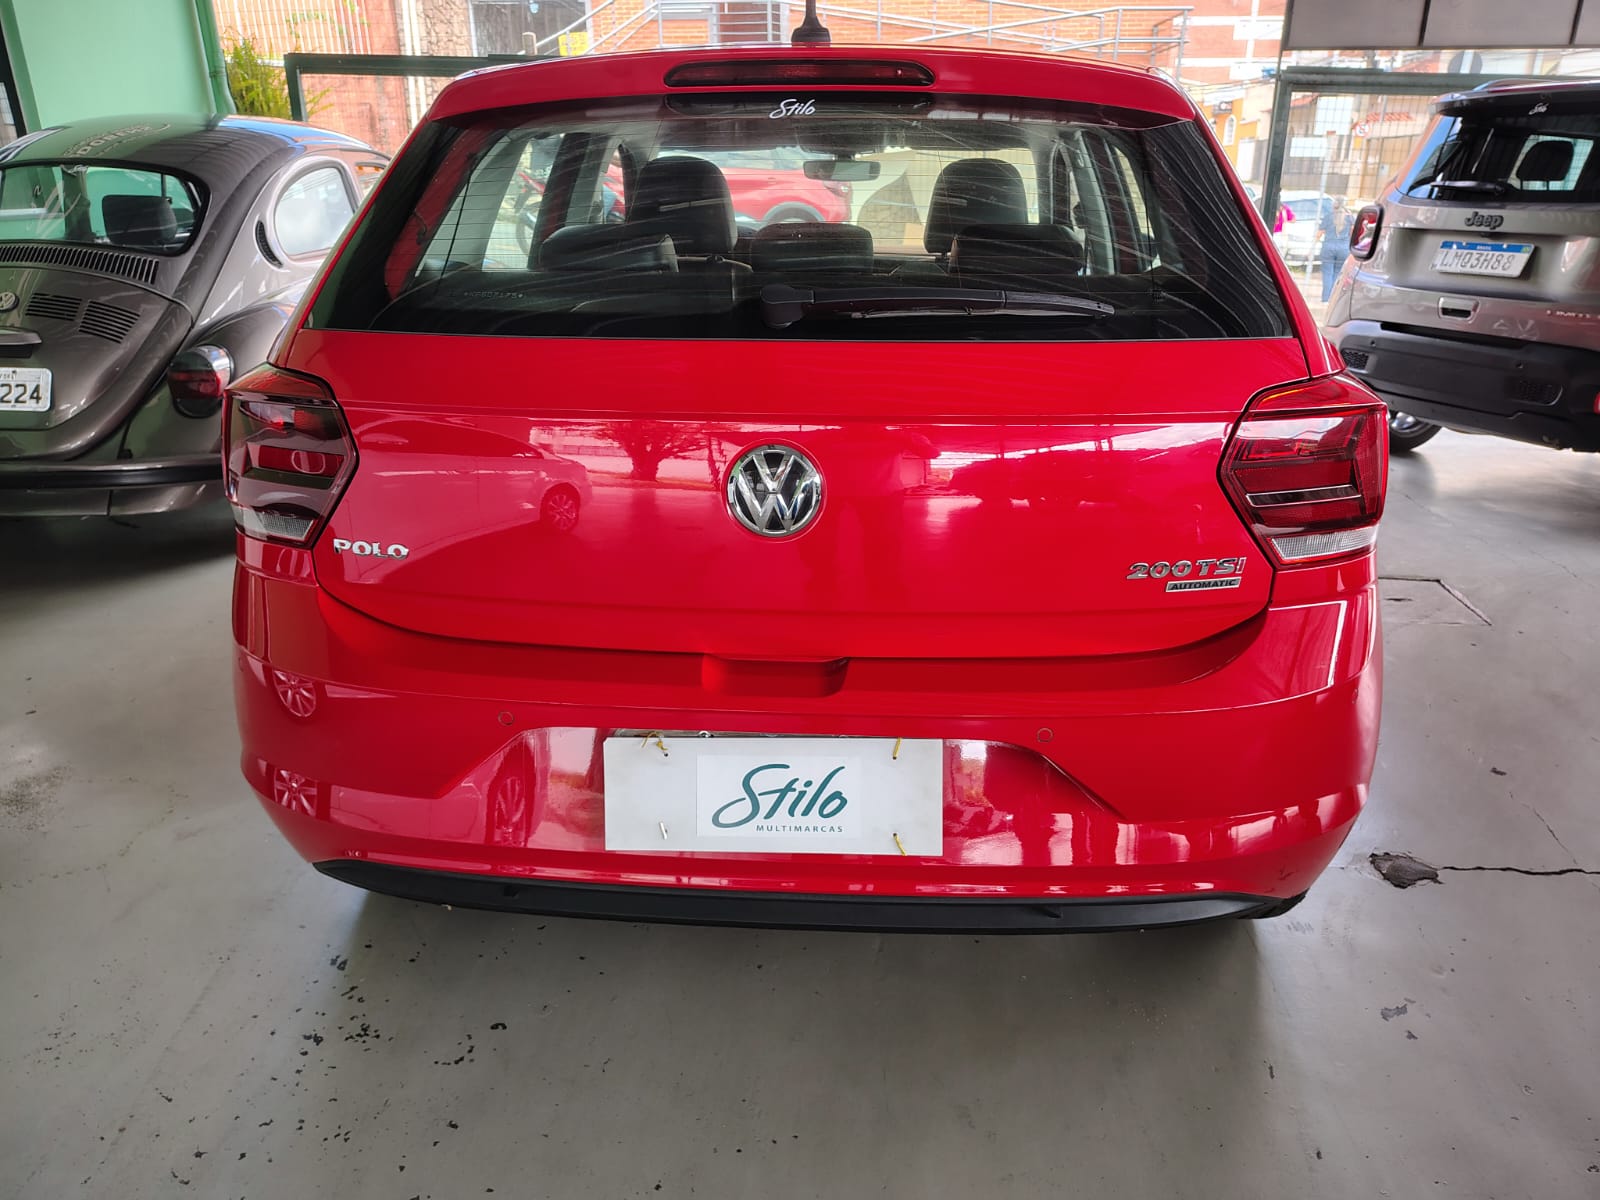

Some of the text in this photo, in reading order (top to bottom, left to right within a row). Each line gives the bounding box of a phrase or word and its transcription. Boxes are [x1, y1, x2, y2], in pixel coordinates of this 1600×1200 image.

[769, 98, 816, 119] Stilo
[1464, 211, 1504, 230] Jeep
[333, 538, 409, 560] POLO
[1170, 577, 1239, 591] AUTOMATIC
[712, 763, 848, 829] Stilo
[755, 824, 843, 833] MULTIMARCAS
